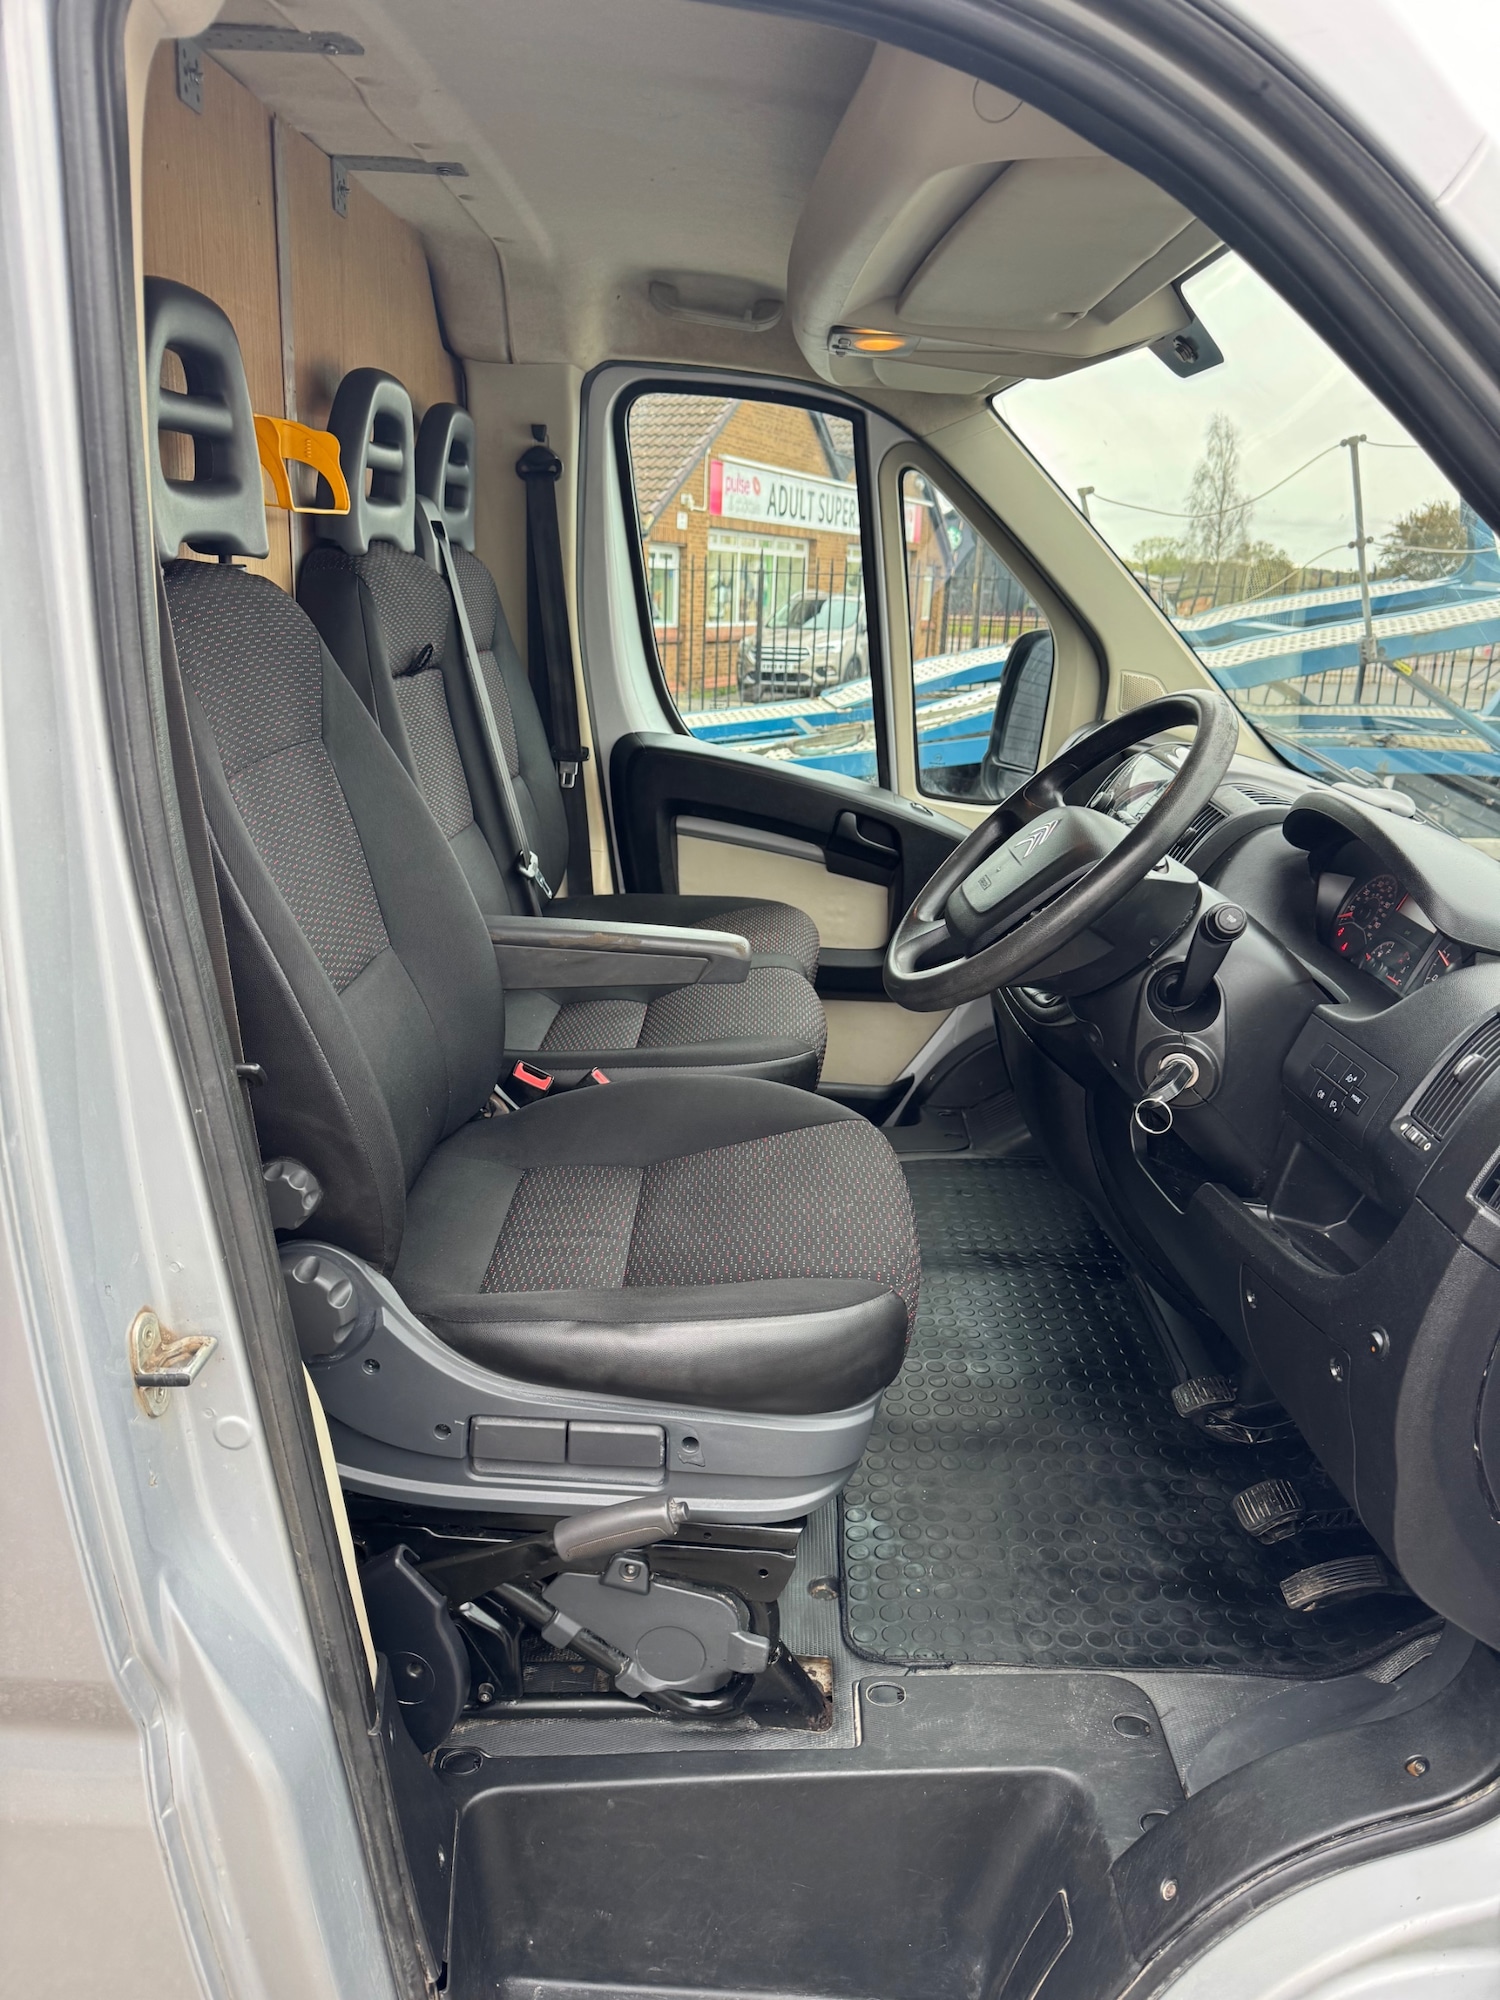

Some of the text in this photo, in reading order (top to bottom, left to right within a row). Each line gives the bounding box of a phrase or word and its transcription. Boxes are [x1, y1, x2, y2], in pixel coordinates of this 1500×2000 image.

[725, 474, 750, 495] pulse
[767, 483, 815, 521] ADULT
[818, 493, 859, 528] SUPER
